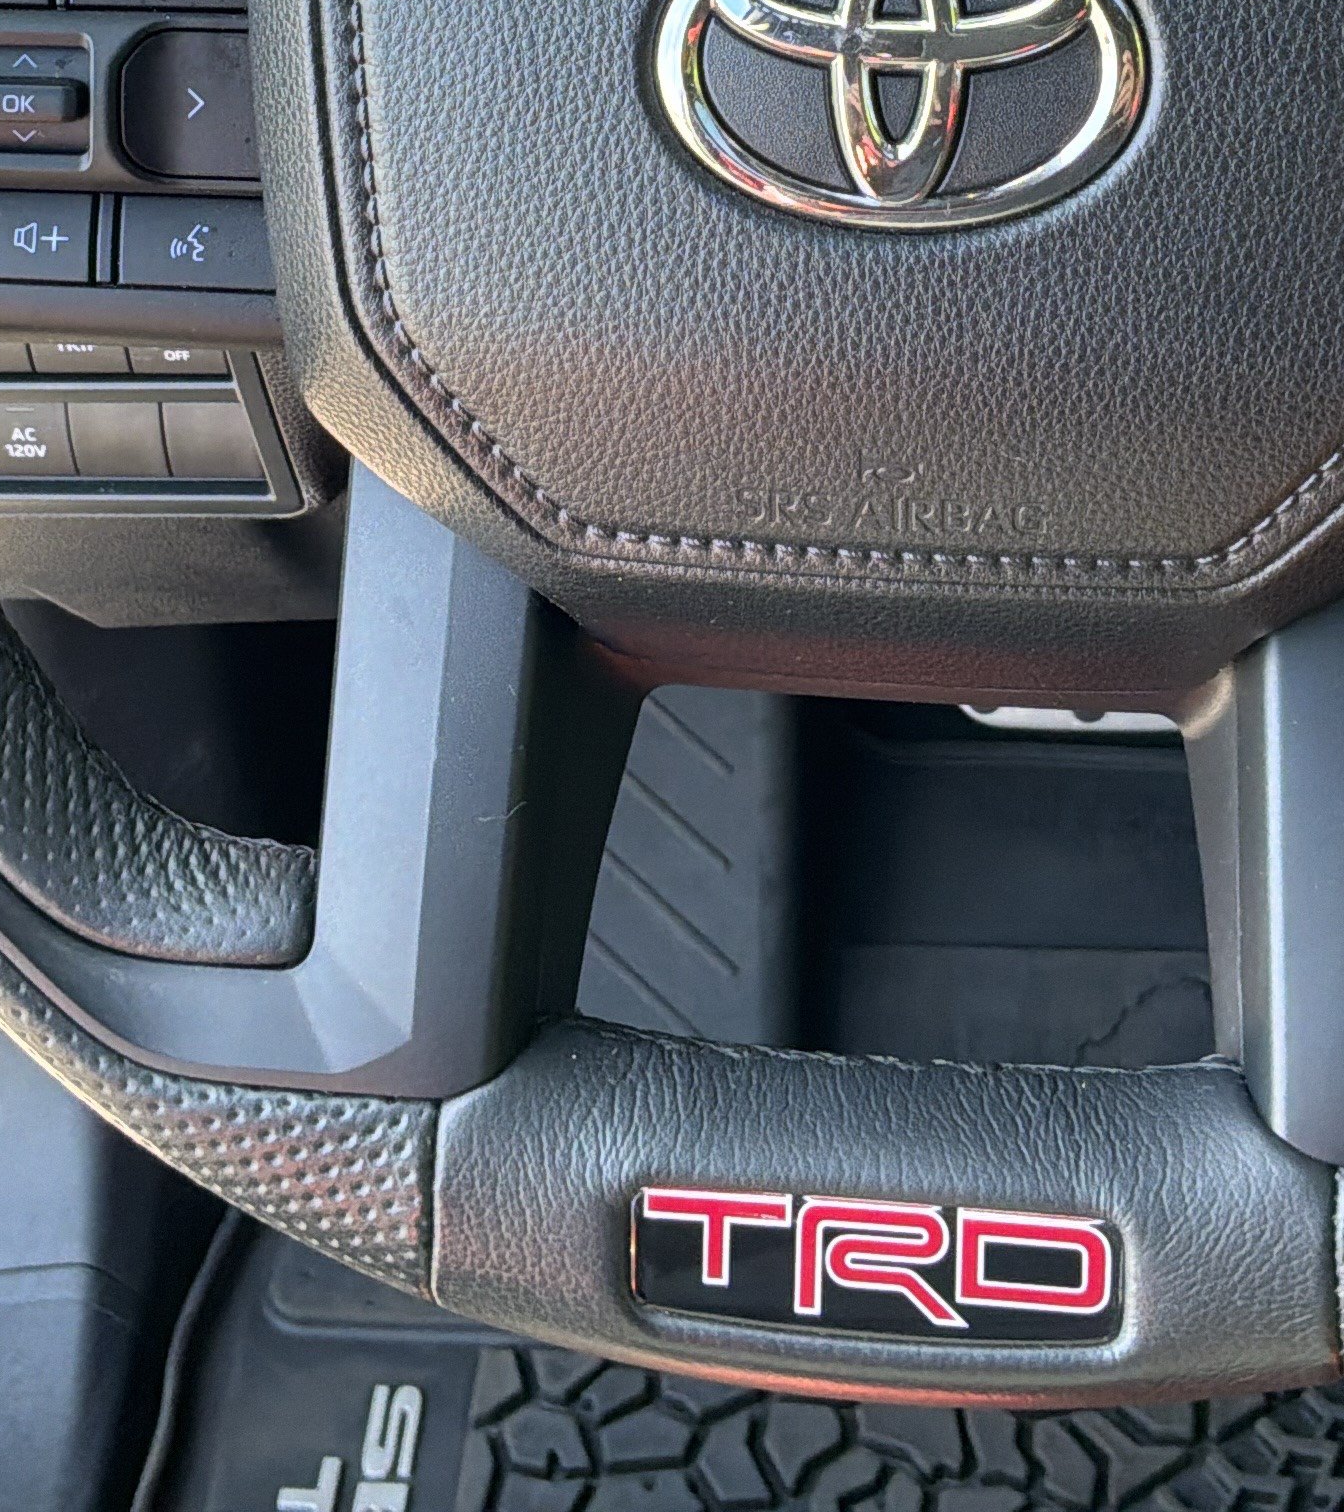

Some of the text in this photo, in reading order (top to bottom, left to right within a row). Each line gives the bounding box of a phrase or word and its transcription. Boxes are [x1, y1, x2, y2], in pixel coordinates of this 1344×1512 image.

[1, 93, 35, 114] OK
[163, 349, 191, 362] OFF
[11, 427, 37, 443] AC
[4, 442, 47, 459] 120V
[855, 494, 1050, 535] AIRBAG
[642, 1186, 1112, 1329] TRD
